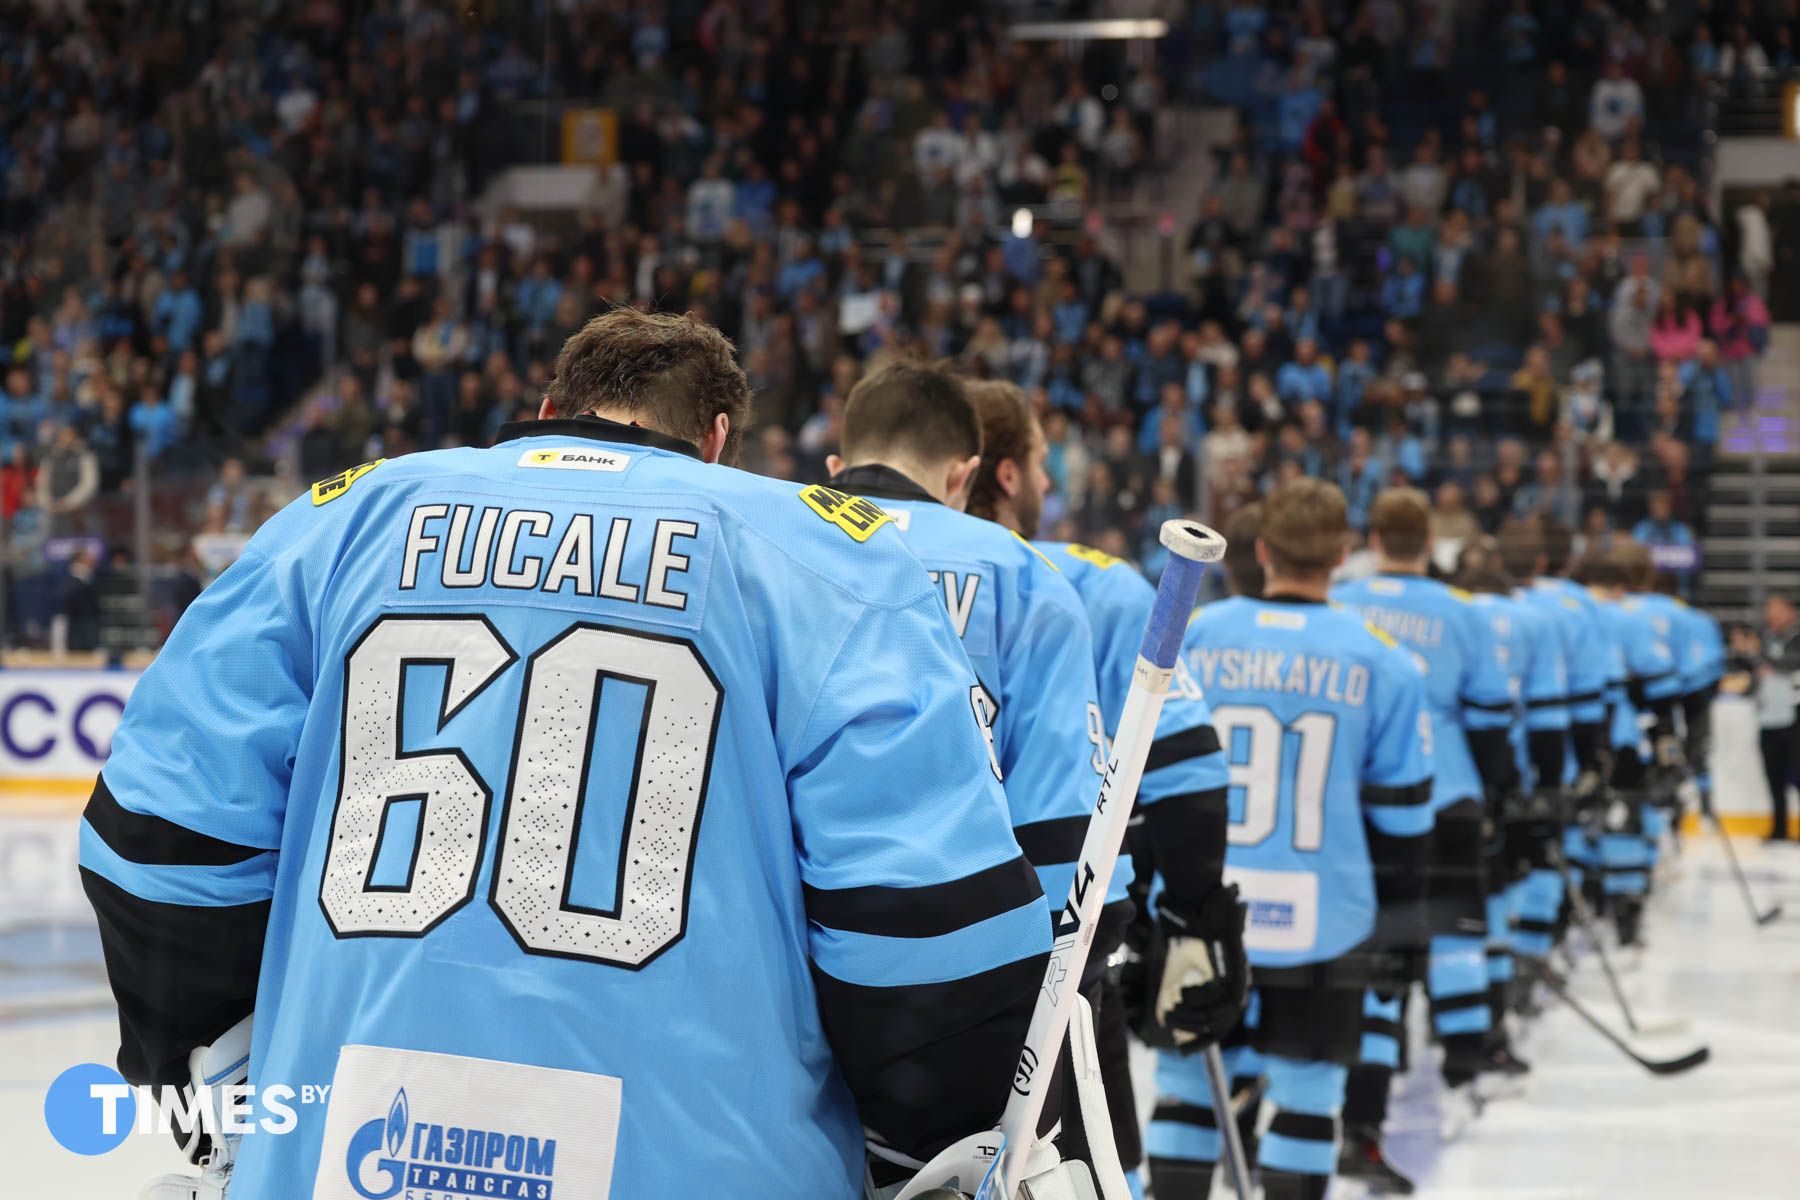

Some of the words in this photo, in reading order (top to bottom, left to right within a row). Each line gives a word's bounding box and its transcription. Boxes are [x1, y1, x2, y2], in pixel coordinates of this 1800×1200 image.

[561, 454, 617, 466] БАНК
[808, 486, 853, 514] MA
[840, 498, 888, 532] LIN
[399, 503, 698, 611] FUCALE
[318, 612, 726, 972] 60
[1097, 758, 1119, 815] RTL
[1211, 704, 1338, 853] 91
[410, 1122, 557, 1177] ГАЗПРОМ
[412, 1167, 548, 1200] ТРАНСГАЗ
